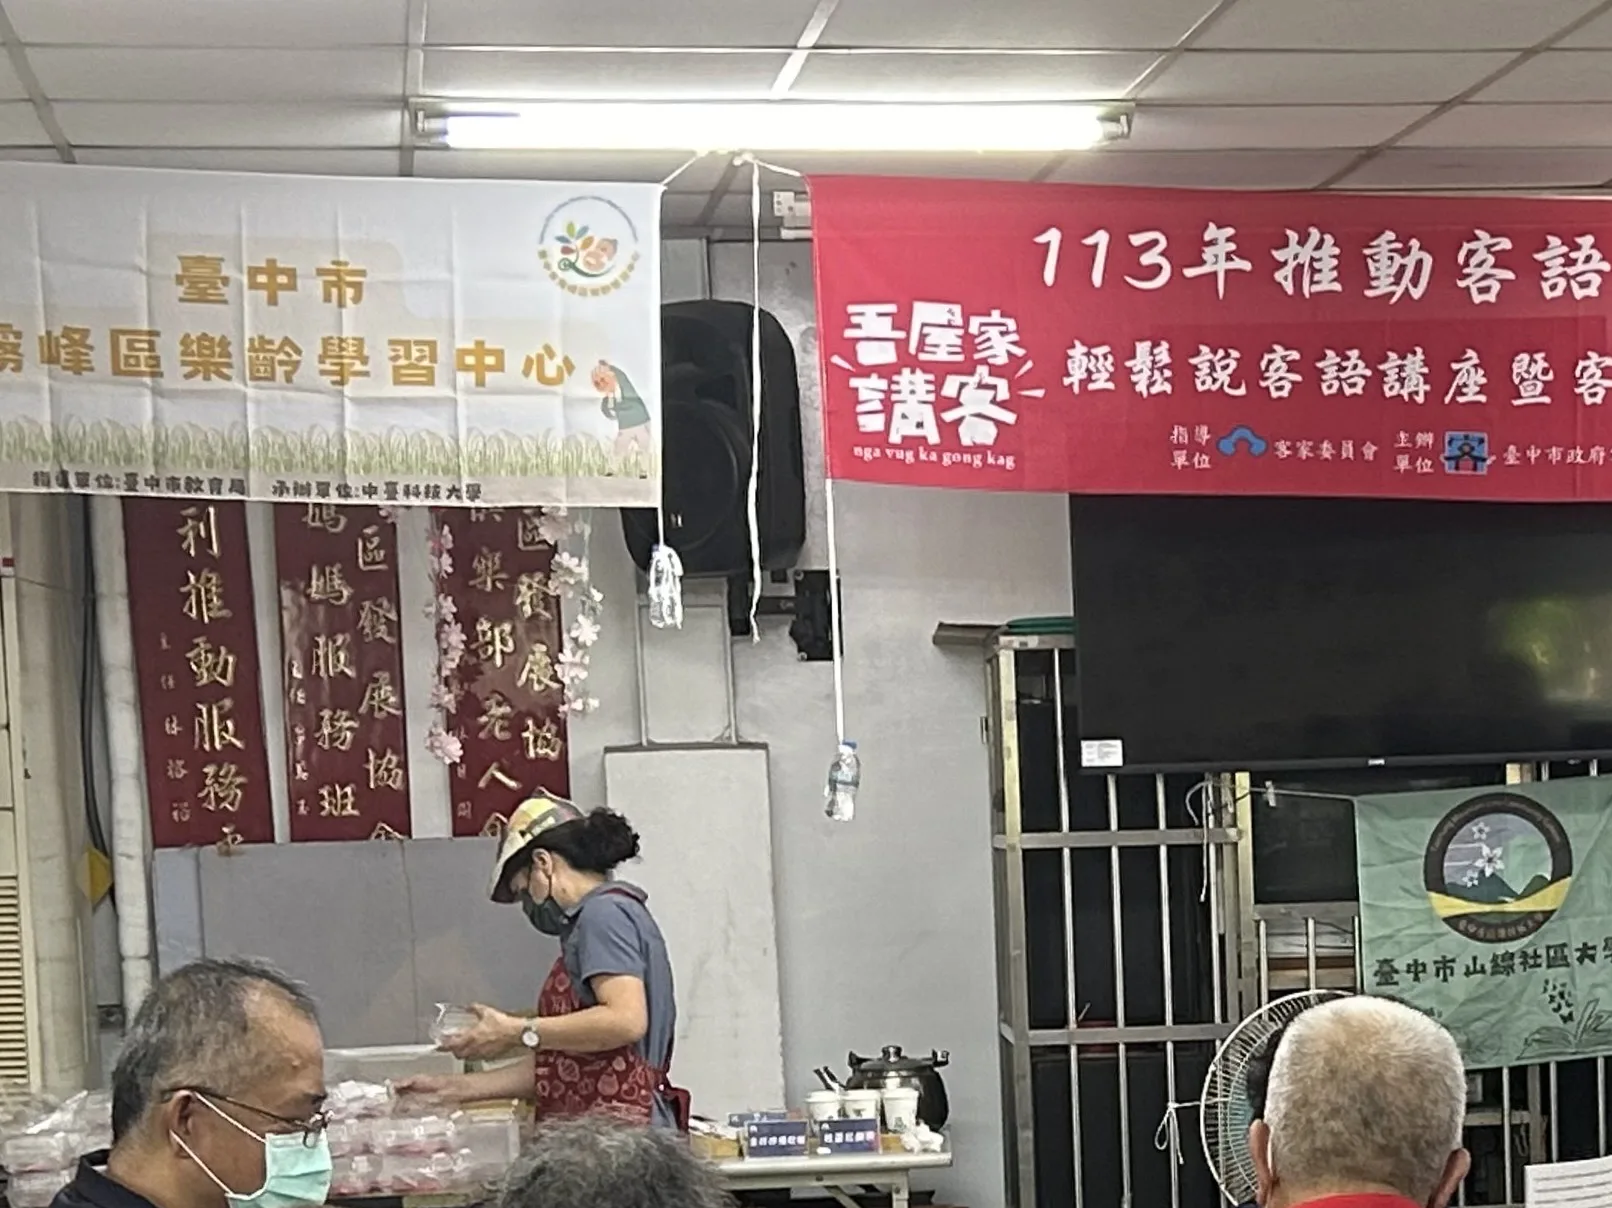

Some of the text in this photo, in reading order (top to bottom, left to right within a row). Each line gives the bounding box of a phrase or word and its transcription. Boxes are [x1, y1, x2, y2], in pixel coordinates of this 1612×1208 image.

[175, 254, 367, 308] 臺中市
[843, 301, 1028, 366] 吾屋家
[848, 365, 1019, 447] 講客
[942, 452, 983, 470] gong
[1274, 437, 1379, 463] 客家委員會
